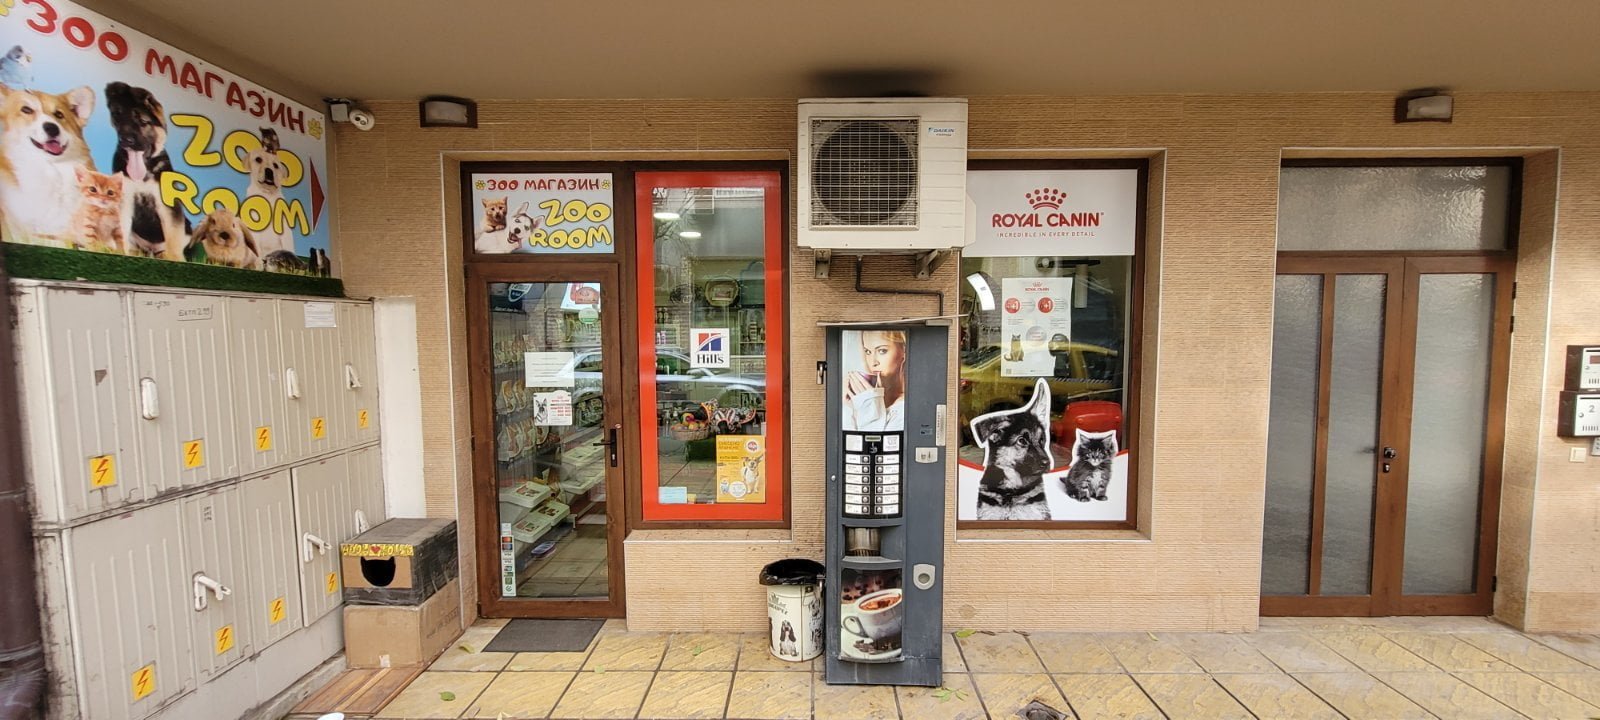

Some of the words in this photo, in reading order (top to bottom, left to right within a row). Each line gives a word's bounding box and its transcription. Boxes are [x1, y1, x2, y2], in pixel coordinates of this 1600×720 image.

[24, 0, 128, 61] ЗОО
[144, 47, 305, 134] МАГАЗИН
[170, 114, 304, 187] ZOO
[487, 179, 519, 190] ЗОО
[524, 179, 600, 190] МАГАЗИН
[160, 170, 310, 236] ROOM
[538, 199, 611, 227] ZOO
[992, 213, 1043, 228] ROYAL
[1046, 212, 1100, 227] CANIN
[529, 224, 612, 249] ROOM
[697, 353, 724, 364] Hill's
[1588, 404, 1596, 413] 2
